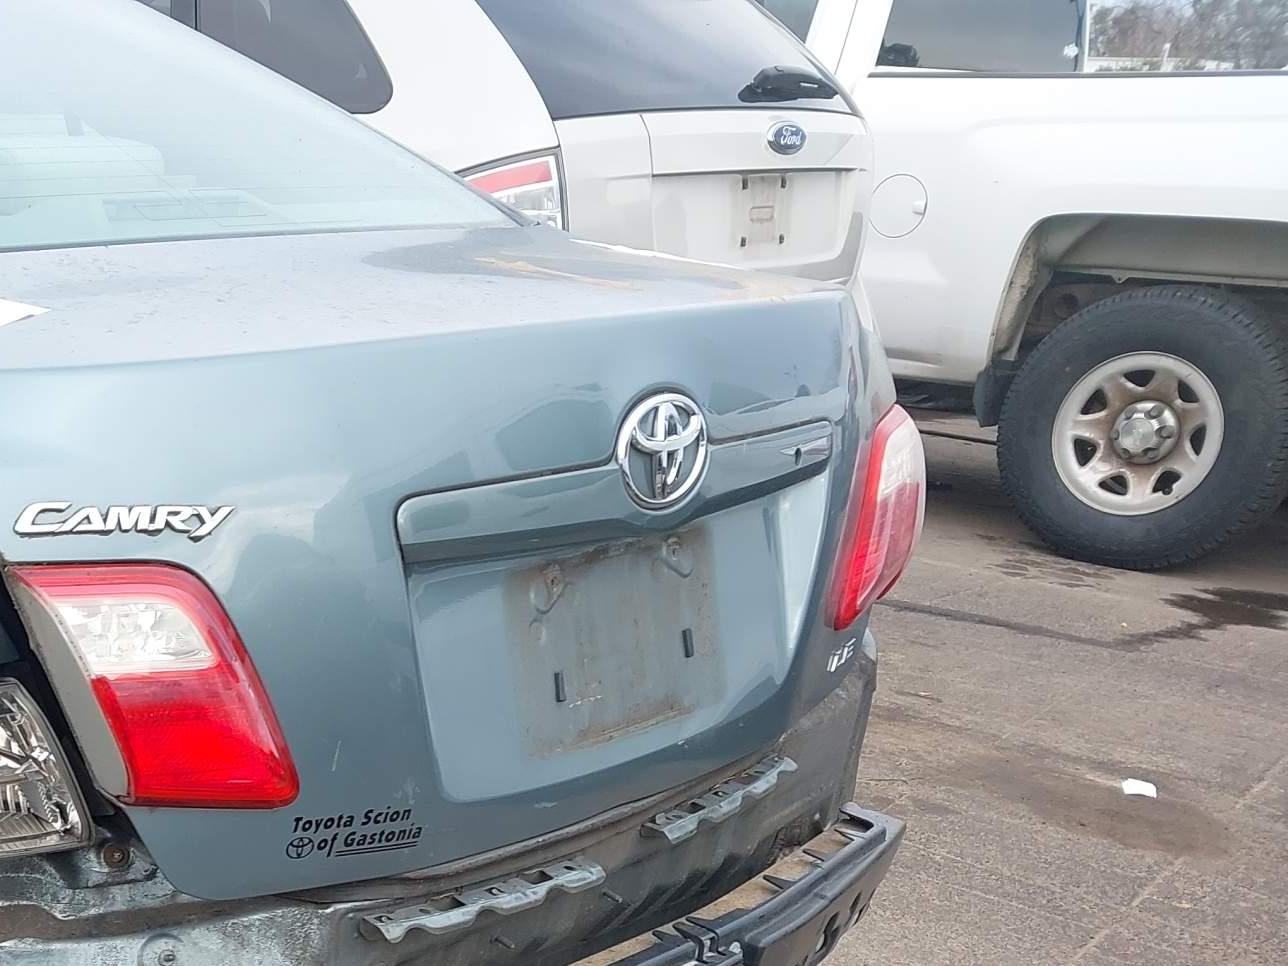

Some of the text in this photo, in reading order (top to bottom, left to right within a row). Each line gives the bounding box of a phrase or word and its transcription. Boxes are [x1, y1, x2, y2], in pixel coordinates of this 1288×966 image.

[781, 126, 802, 145] Ford
[13, 500, 236, 542] CAMRY
[827, 638, 856, 672] LE
[293, 806, 412, 834] Toyota Scion
[316, 822, 423, 858] of Gastonia
